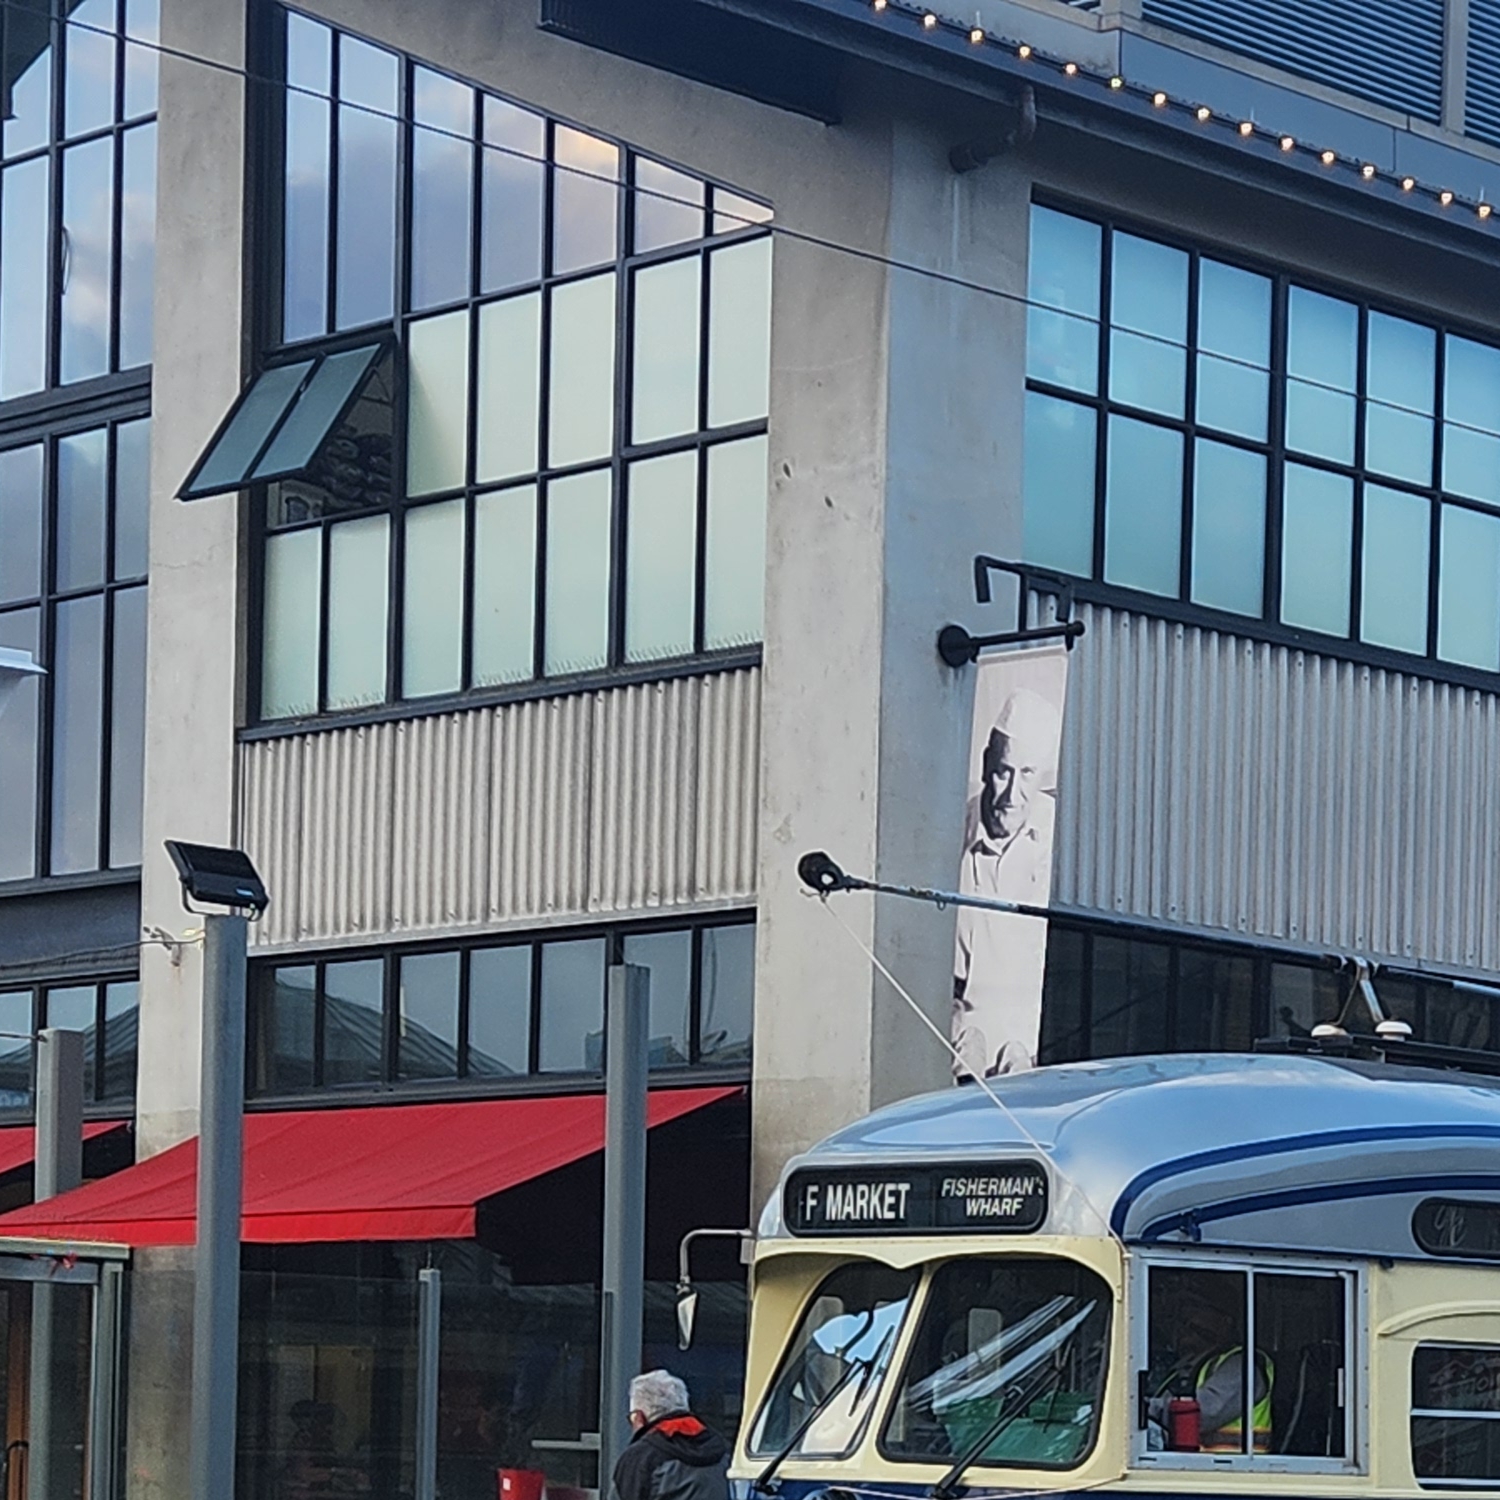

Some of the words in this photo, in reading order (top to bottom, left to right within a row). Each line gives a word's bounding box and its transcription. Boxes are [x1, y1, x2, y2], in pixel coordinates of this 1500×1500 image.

[805, 1184, 820, 1221] F
[825, 1182, 911, 1221] MARKET
[966, 1198, 1024, 1217] WHARF
